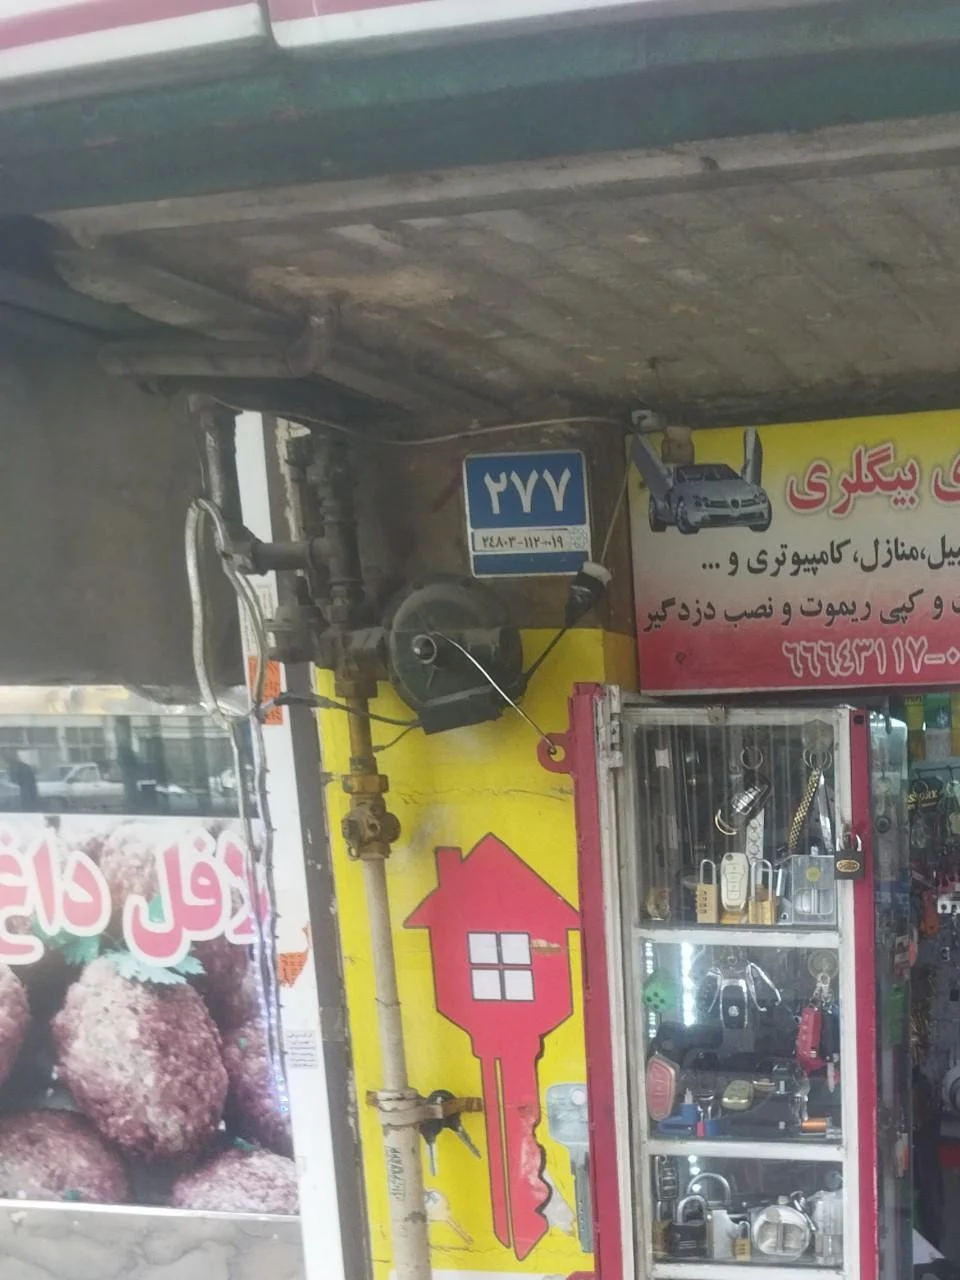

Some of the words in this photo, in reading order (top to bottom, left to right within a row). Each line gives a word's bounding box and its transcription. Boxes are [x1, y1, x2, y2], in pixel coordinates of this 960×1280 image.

[484, 468, 571, 515] ۲۷۷
[788, 443, 918, 515] بیگلری
[747, 539, 851, 577] کامپیوتری
[723, 596, 774, 629] نصب
[781, 602, 792, 626] و
[800, 597, 872, 627] ریموت
[879, 588, 924, 625] کپی
[932, 595, 944, 620] و
